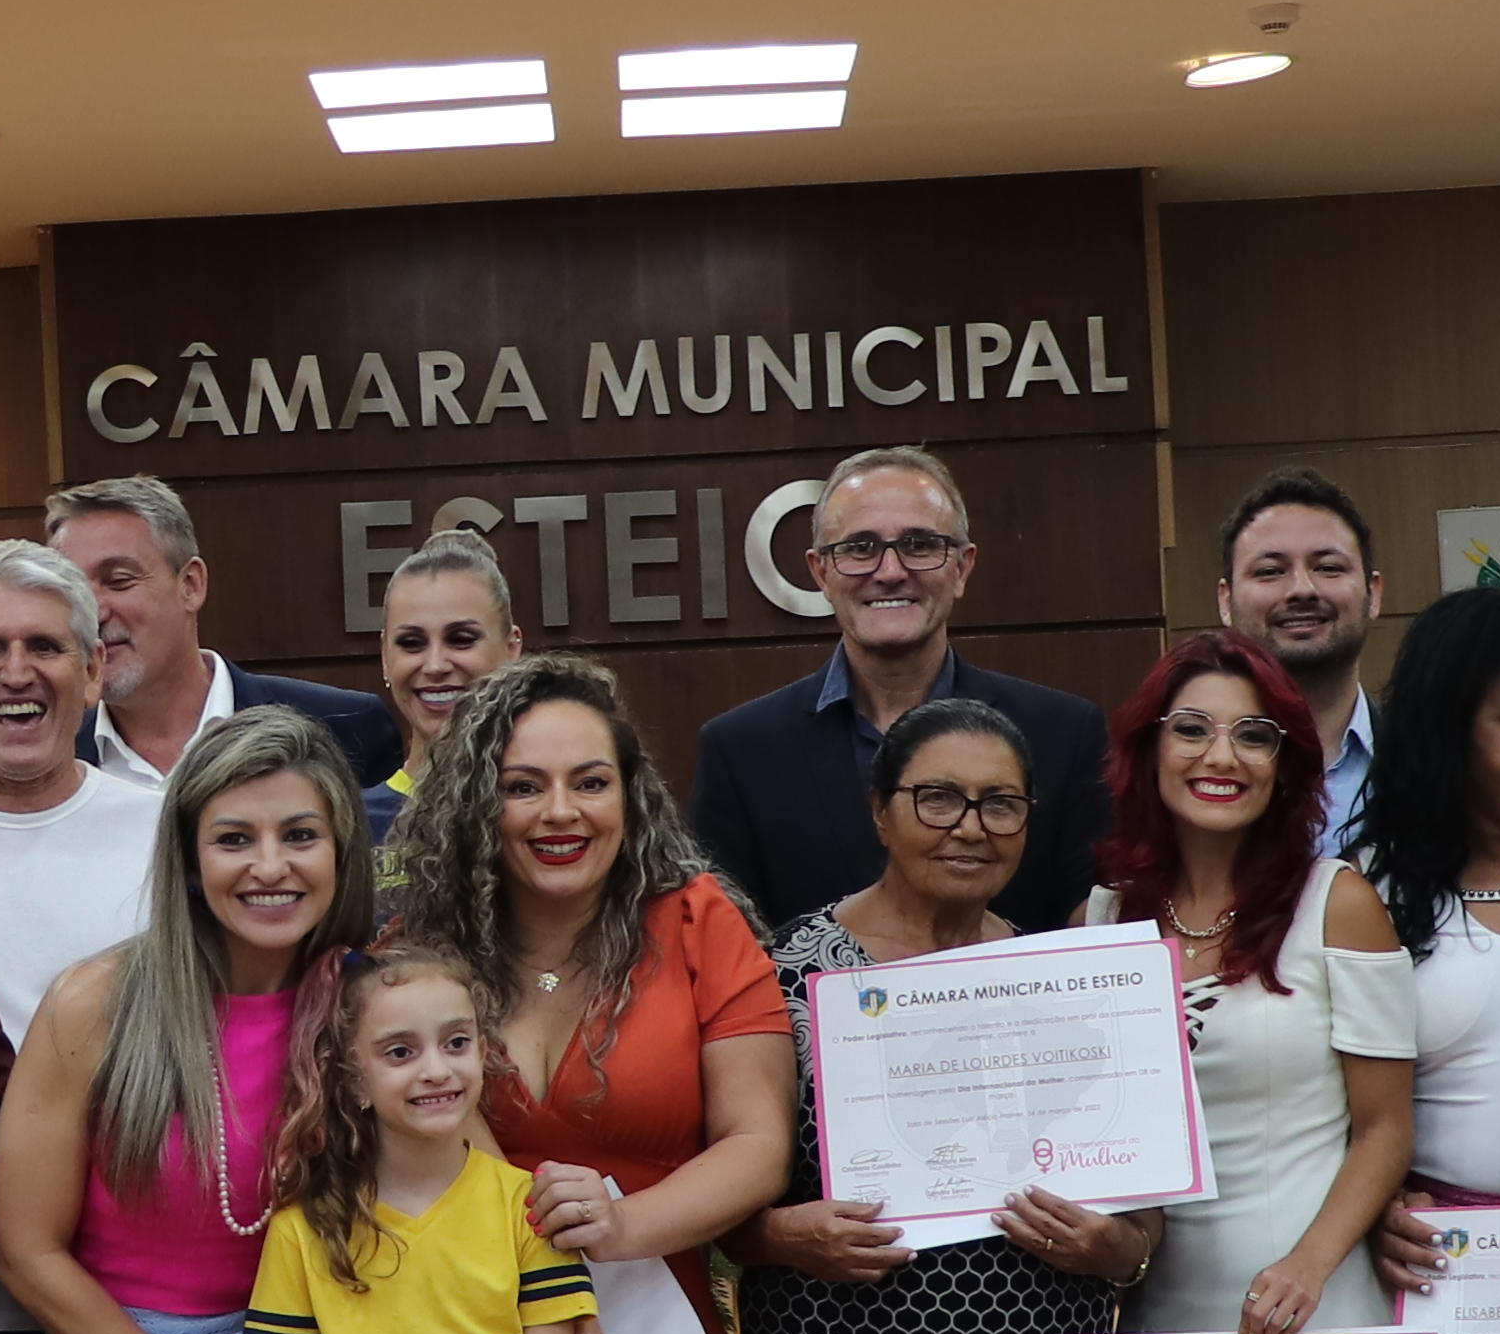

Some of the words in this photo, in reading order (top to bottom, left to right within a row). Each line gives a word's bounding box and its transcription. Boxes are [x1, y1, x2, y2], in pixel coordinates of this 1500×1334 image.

[87, 342, 549, 443] CÂMARA
[582, 316, 1129, 419] MUNICIPAL
[894, 984, 970, 1008] CÂMARA
[973, 978, 1063, 1000] MUNICIPAL
[1066, 976, 1087, 991] DE
[1091, 970, 1144, 989] ESTEIO
[887, 1060, 936, 1077] MARIA
[939, 1058, 959, 1072] DE
[962, 1052, 1028, 1070] LOURDES
[1030, 1044, 1111, 1063] VOITIKOSKI
[1058, 1143, 1139, 1172] Mulher
